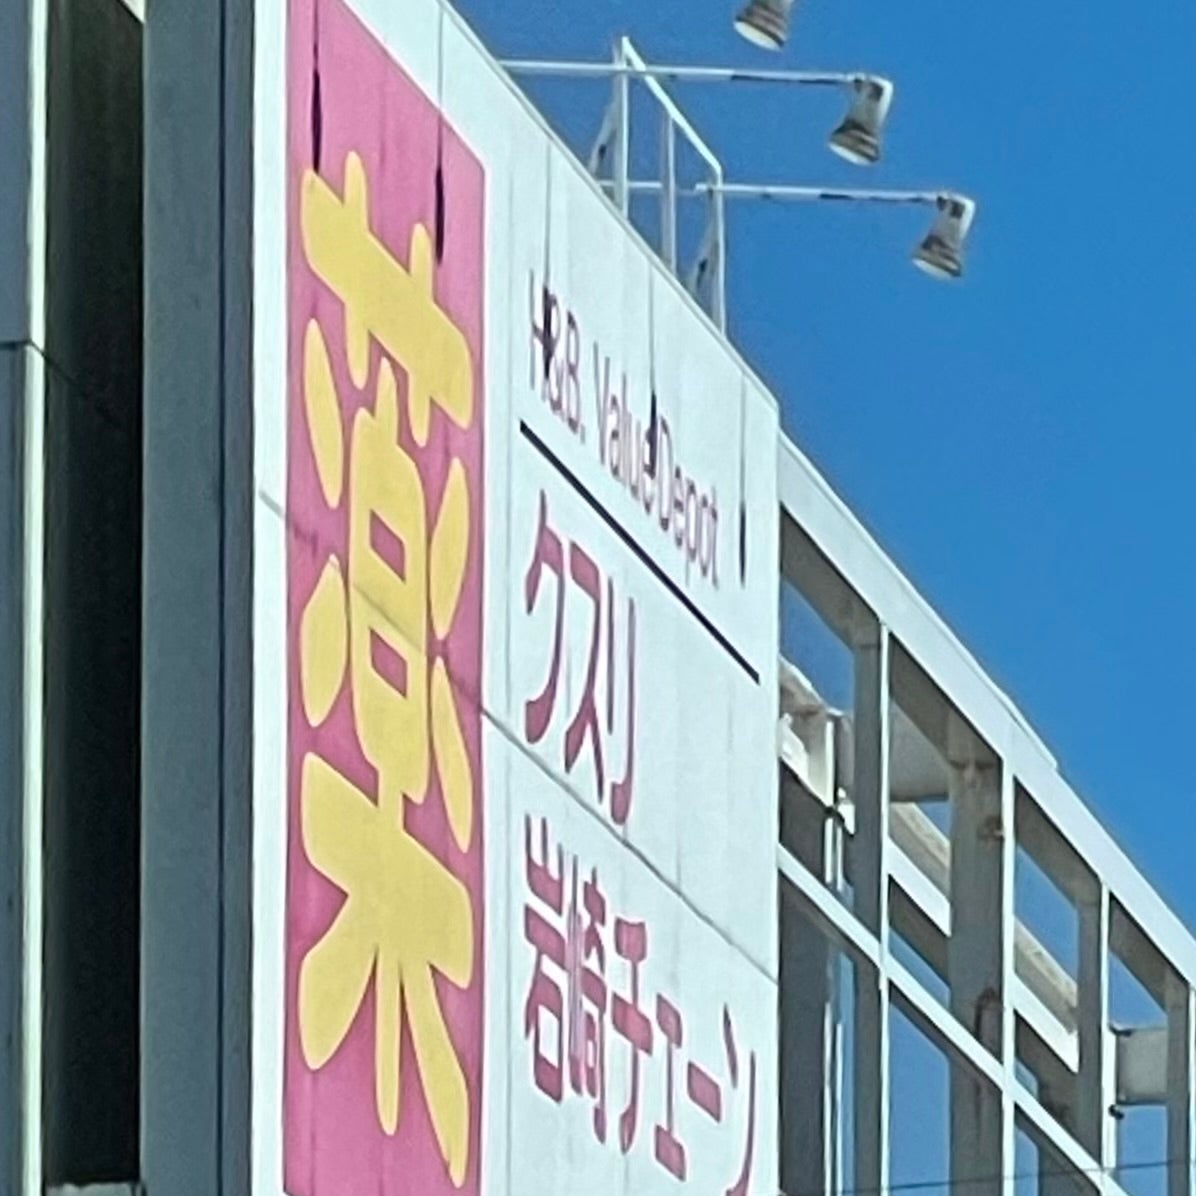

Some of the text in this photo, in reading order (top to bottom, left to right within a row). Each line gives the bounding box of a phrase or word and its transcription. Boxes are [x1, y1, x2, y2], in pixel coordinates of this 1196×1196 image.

[300, 149, 474, 1189] 薬
[525, 488, 636, 826] クスリ
